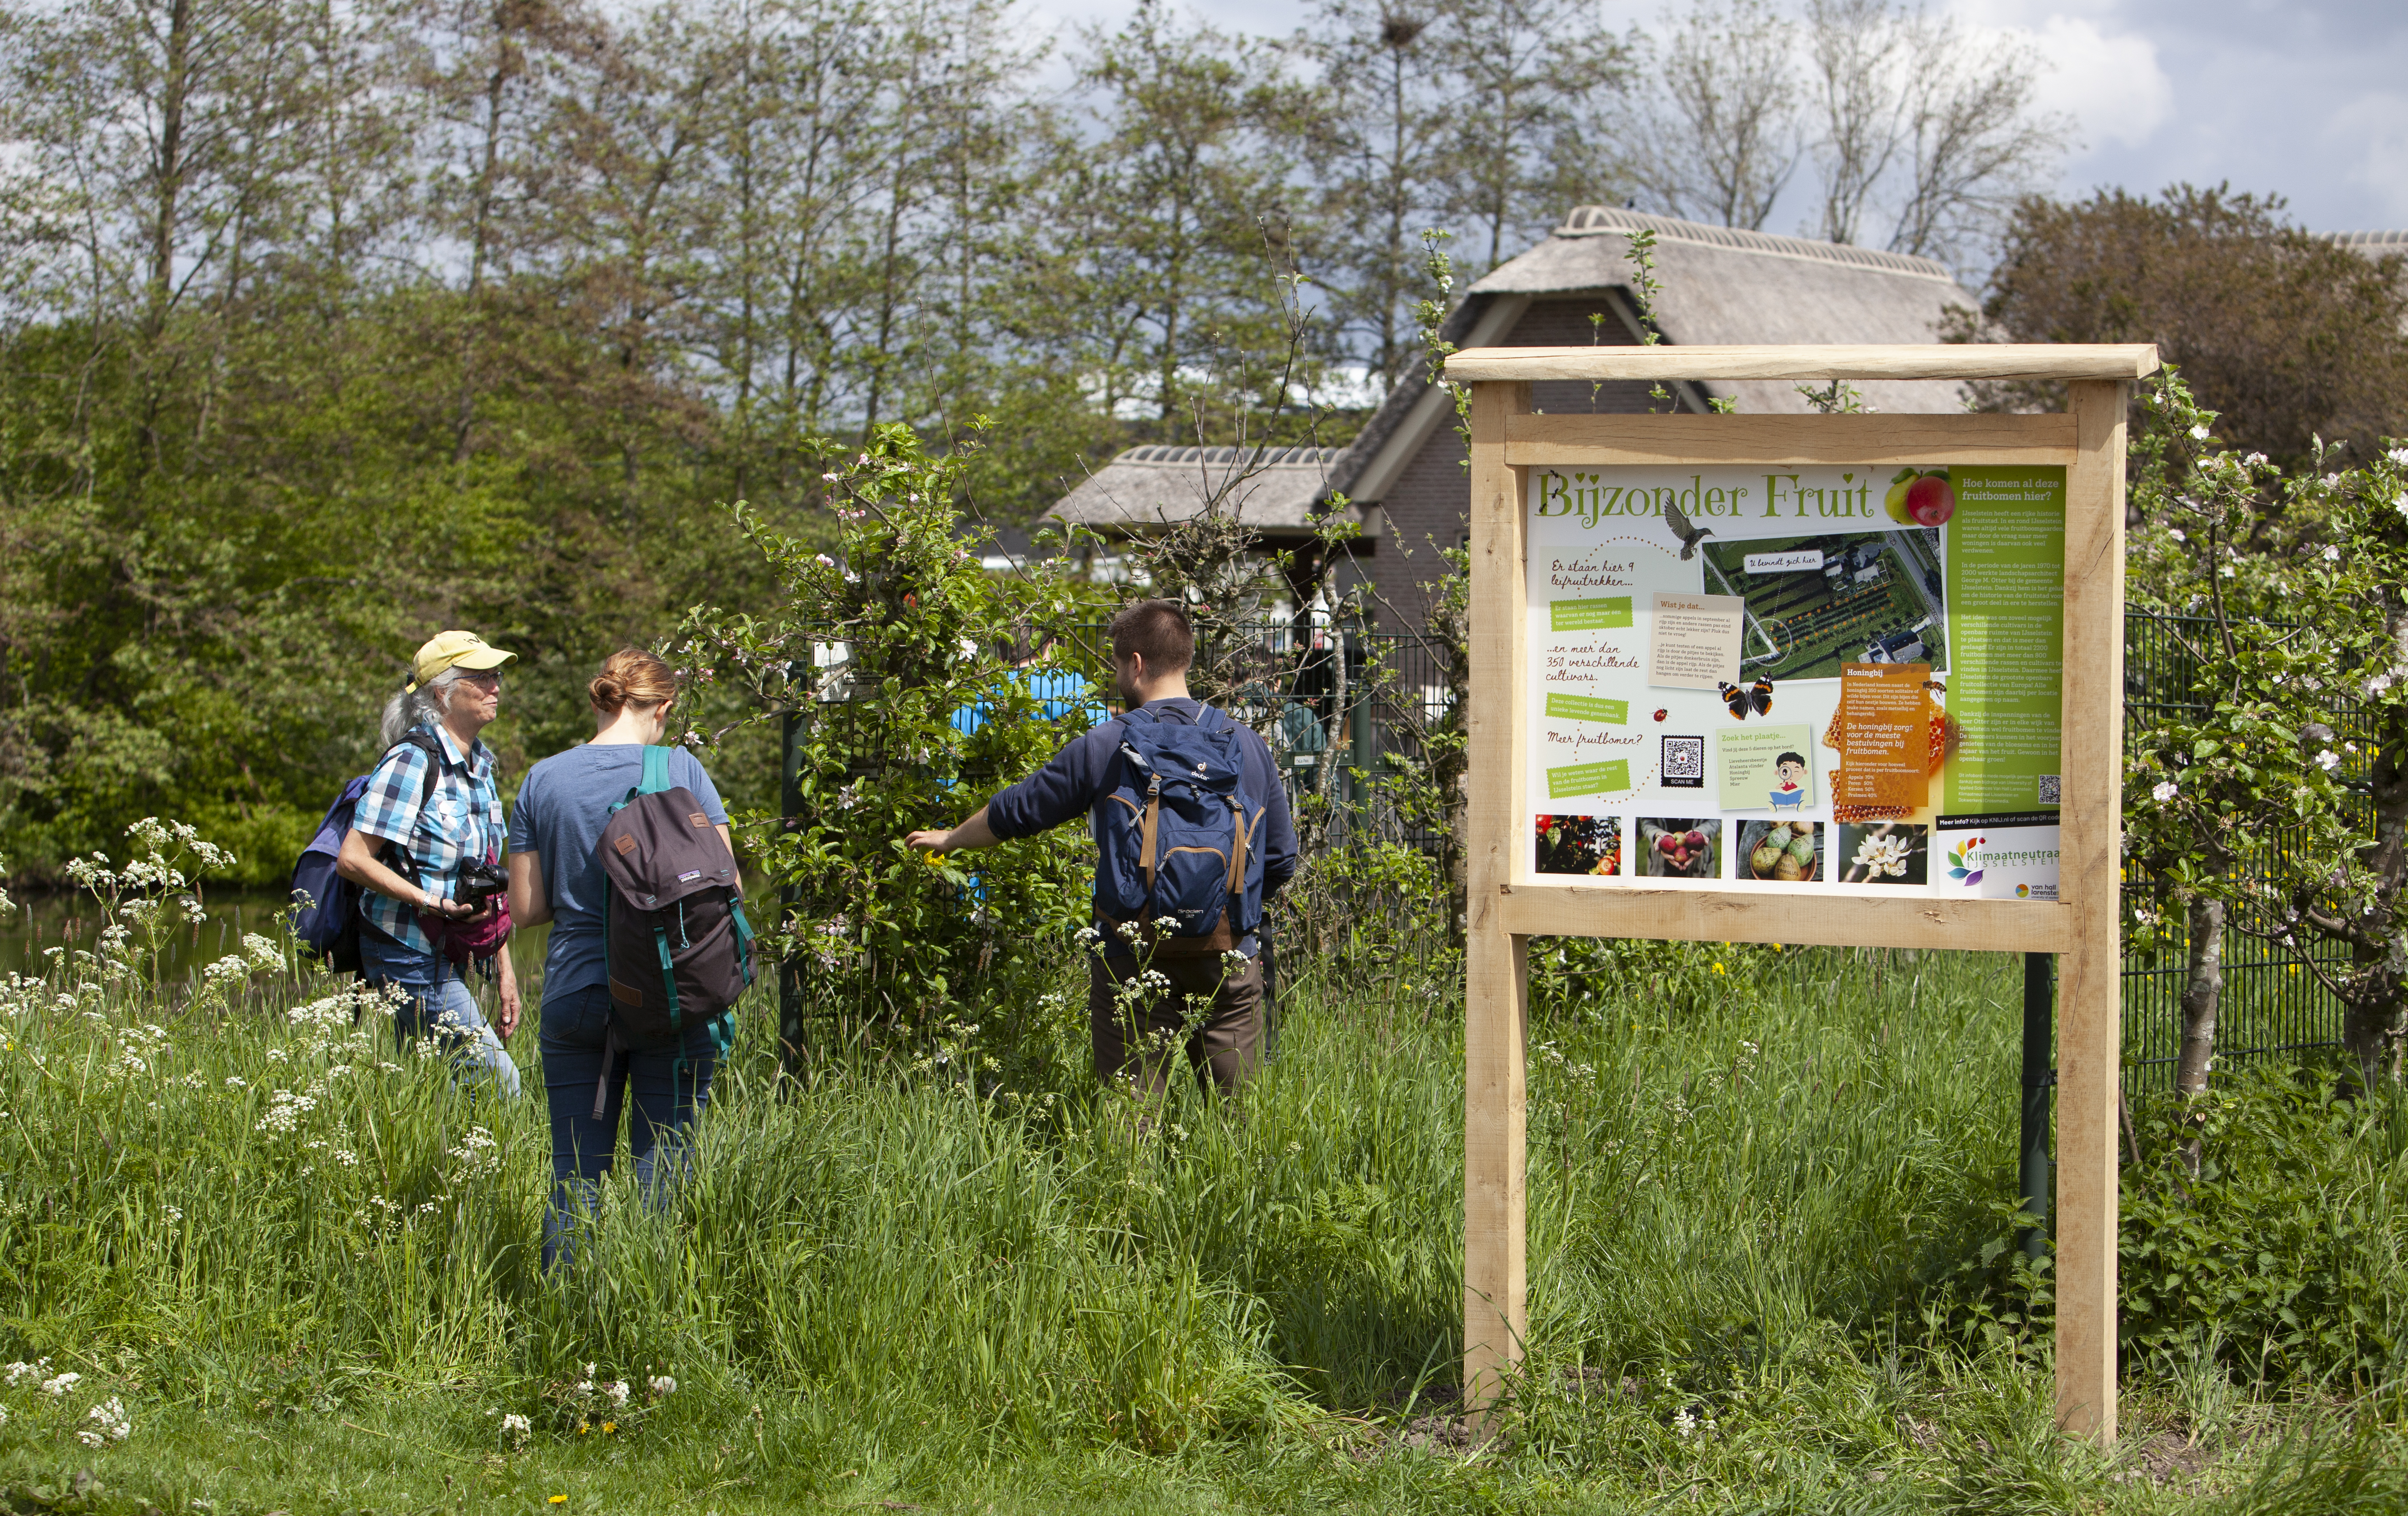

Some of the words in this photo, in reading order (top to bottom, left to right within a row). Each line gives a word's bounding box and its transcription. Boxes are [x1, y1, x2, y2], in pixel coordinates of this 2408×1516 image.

[1962, 478, 1982, 487] Hoe
[1985, 479, 2020, 487] komen
[2022, 479, 2032, 487] al
[2035, 479, 2058, 488] deze
[1533, 472, 1747, 529] Bijzonder
[1759, 472, 1874, 519] Fruit
[1962, 491, 2021, 500] fruitbomen
[2024, 491, 2051, 500] hier?
[1884, 530, 1897, 546] endijk
[1552, 559, 1565, 571] Er
[1568, 559, 1599, 572] staan
[1602, 560, 1624, 572] hier
[1628, 562, 1634, 572] 9
[1758, 557, 1783, 566] bevindt
[1786, 556, 1800, 567] zich
[1551, 574, 1632, 589] leifruitrekken...
[1599, 642, 1620, 653] dan
[1546, 657, 1564, 667] 350
[1569, 656, 1639, 667] verschillende
[1546, 669, 1597, 681] cultivars.
[1847, 669, 1882, 677] Honingbij
[1858, 723, 1892, 732] honingbij
[1547, 731, 1574, 743] Meer
[1576, 732, 1642, 747] fruitbomen?
[1754, 732, 1785, 741] plaatje...
[1846, 739, 1893, 748] bestuivingen
[1895, 740, 1904, 748] bij
[1845, 747, 1888, 755] fruitbomen.
[1191, 771, 1210, 781] deuter
[1553, 785, 1581, 793] IJsselstein
[1967, 849, 2060, 862] Klimaatneutraa
[1967, 858, 2059, 868] IJSSELSTEI
